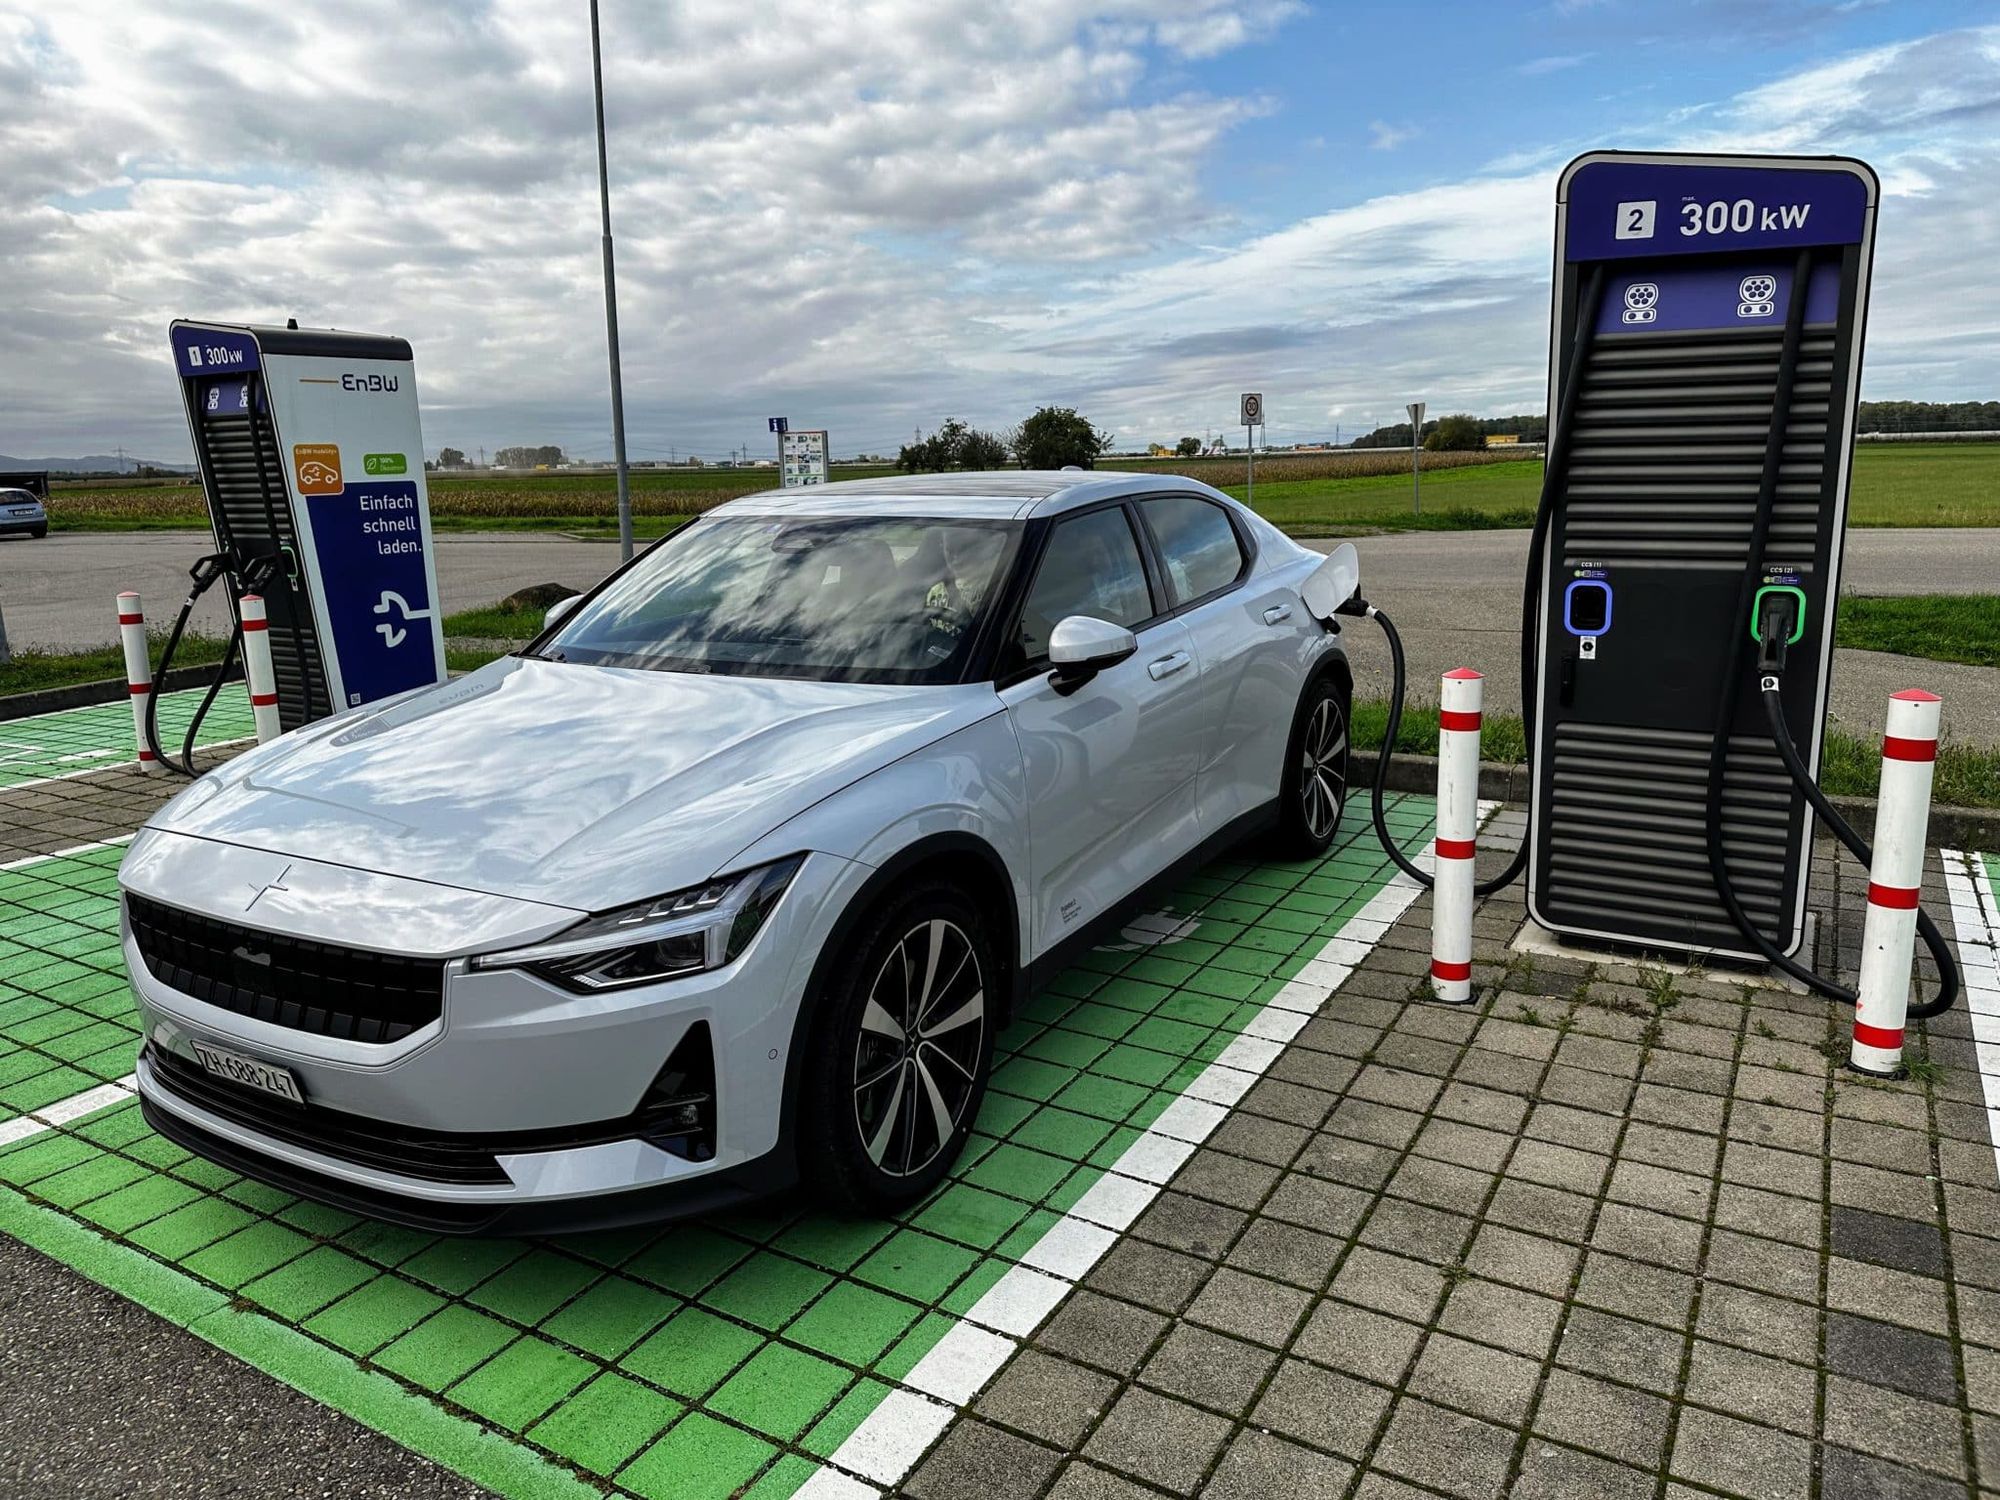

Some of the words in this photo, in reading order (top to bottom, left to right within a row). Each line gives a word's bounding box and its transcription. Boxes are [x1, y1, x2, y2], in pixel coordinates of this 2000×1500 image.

[1628, 209, 1644, 231] 2
[1680, 199, 1755, 236] 300
[1760, 204, 1811, 231] kW
[192, 350, 198, 362] 1
[207, 347, 229, 365] 300
[229, 350, 243, 364] kW
[341, 373, 399, 392] EnBW
[360, 494, 414, 511] Einfach
[363, 516, 416, 533] schnell
[378, 538, 422, 555] laden.
